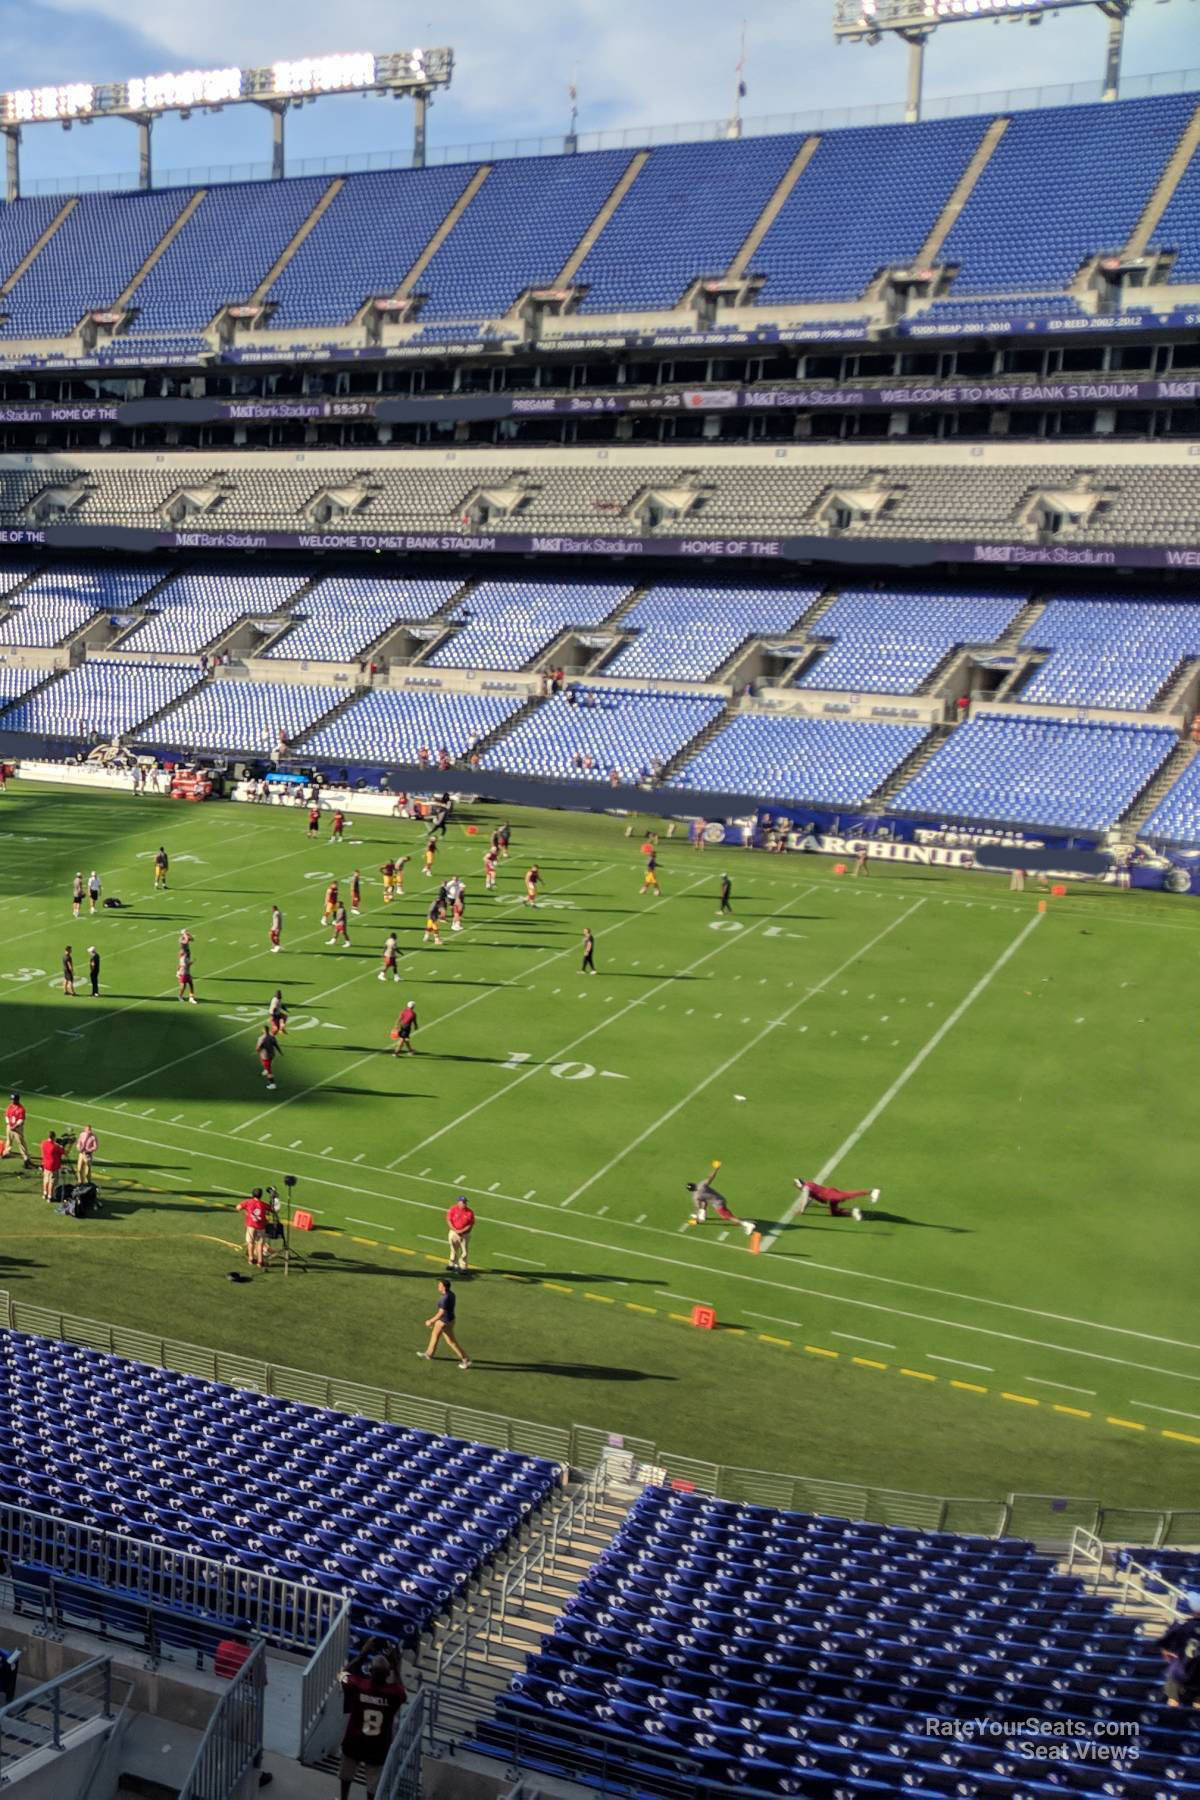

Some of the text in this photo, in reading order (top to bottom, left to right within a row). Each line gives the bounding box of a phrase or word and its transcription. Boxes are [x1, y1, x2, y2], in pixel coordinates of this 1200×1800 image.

[880, 384, 1138, 403] WELCOME TO M&T BANK STADIUM
[1158, 382, 1195, 397] M&T
[664, 395, 680, 406] 25
[745, 392, 777, 406] M&T
[777, 392, 809, 406] Bank
[810, 391, 863, 405] Stadium
[6, 410, 41, 421] Stadium
[51, 408, 118, 420] HOME OF THE
[230, 405, 319, 417] M&T Bank Stadium
[9, 531, 24, 542] OF
[26, 531, 46, 543] THE
[175, 533, 267, 547] M&T Bank Stadium
[299, 535, 496, 550] WELCOME TO M&T BANK STADIUM
[531, 538, 643, 552] M&T Bank Stadium
[681, 540, 779, 555] HOME OF THE
[973, 545, 1115, 564] M&T Bank Stadium
[500, 1051, 597, 1080] 10
[362, 1709, 384, 1736] 8
